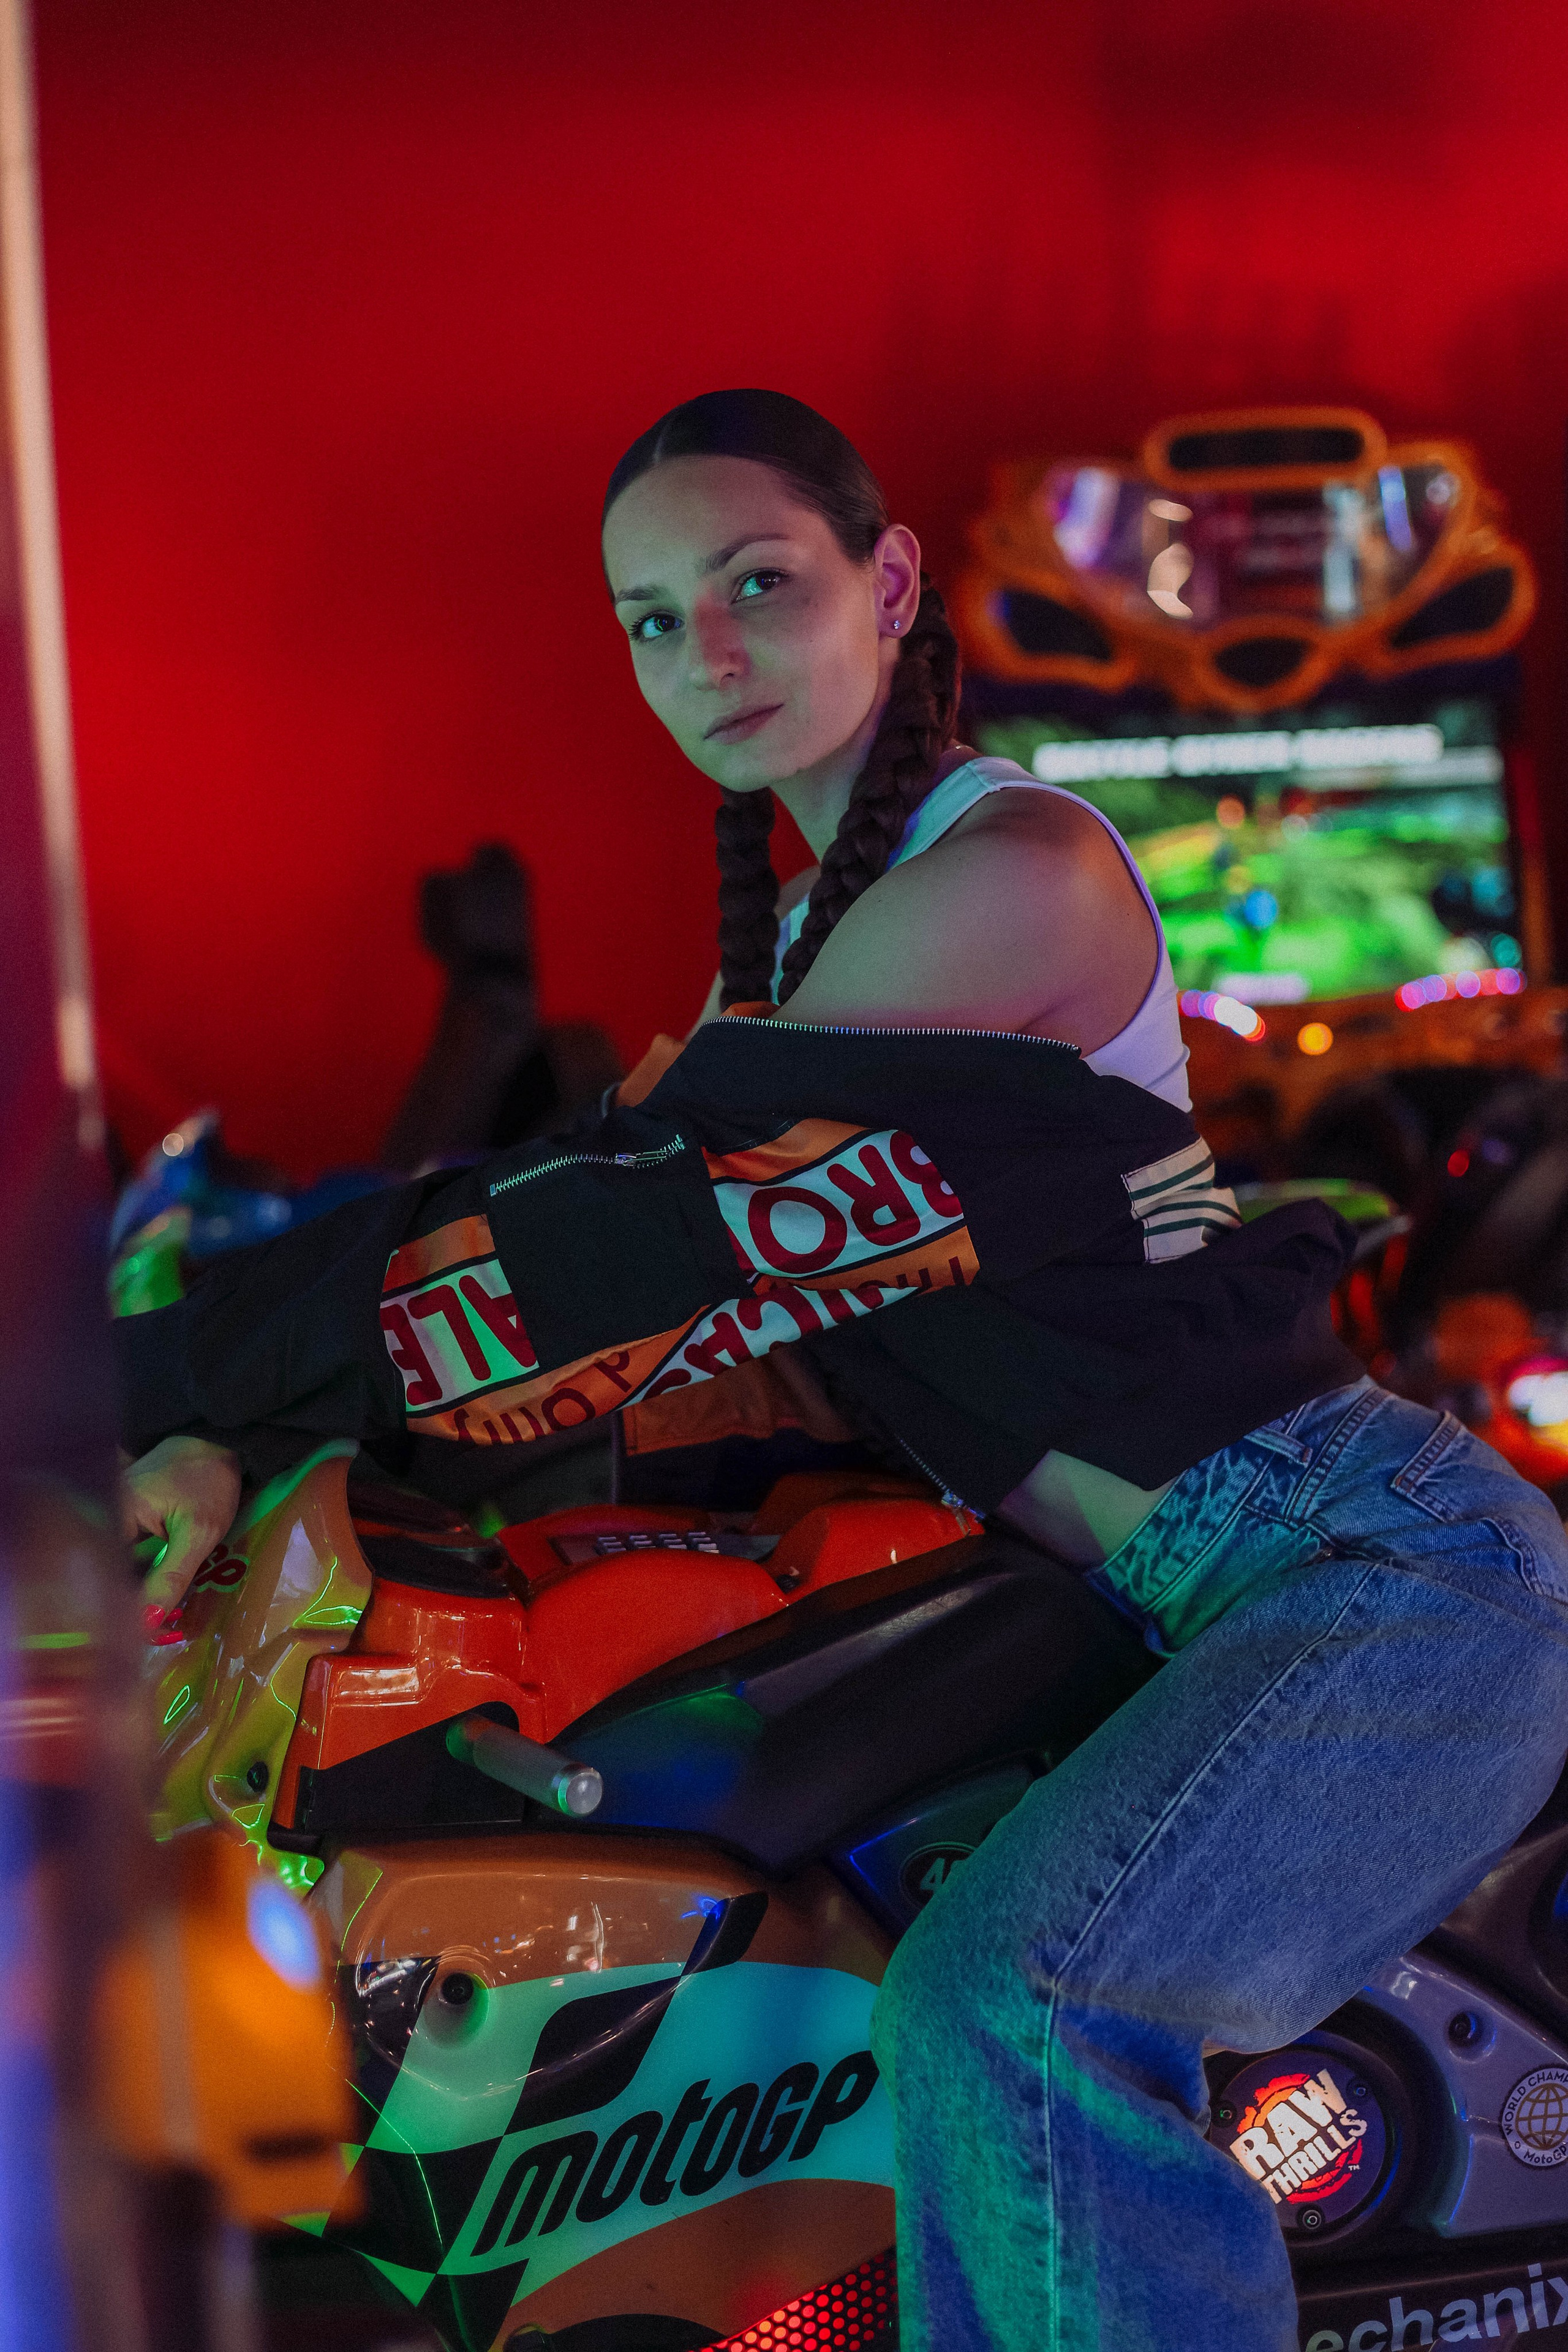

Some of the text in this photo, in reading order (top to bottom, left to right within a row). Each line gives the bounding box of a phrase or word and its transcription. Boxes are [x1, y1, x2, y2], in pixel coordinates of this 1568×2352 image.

[1229, 2068, 1347, 2180] RAW
[1504, 2086, 1526, 2136] WORLD
[1261, 2108, 1368, 2204] THRILLS
[1523, 2145, 1567, 2164] MotoGP
